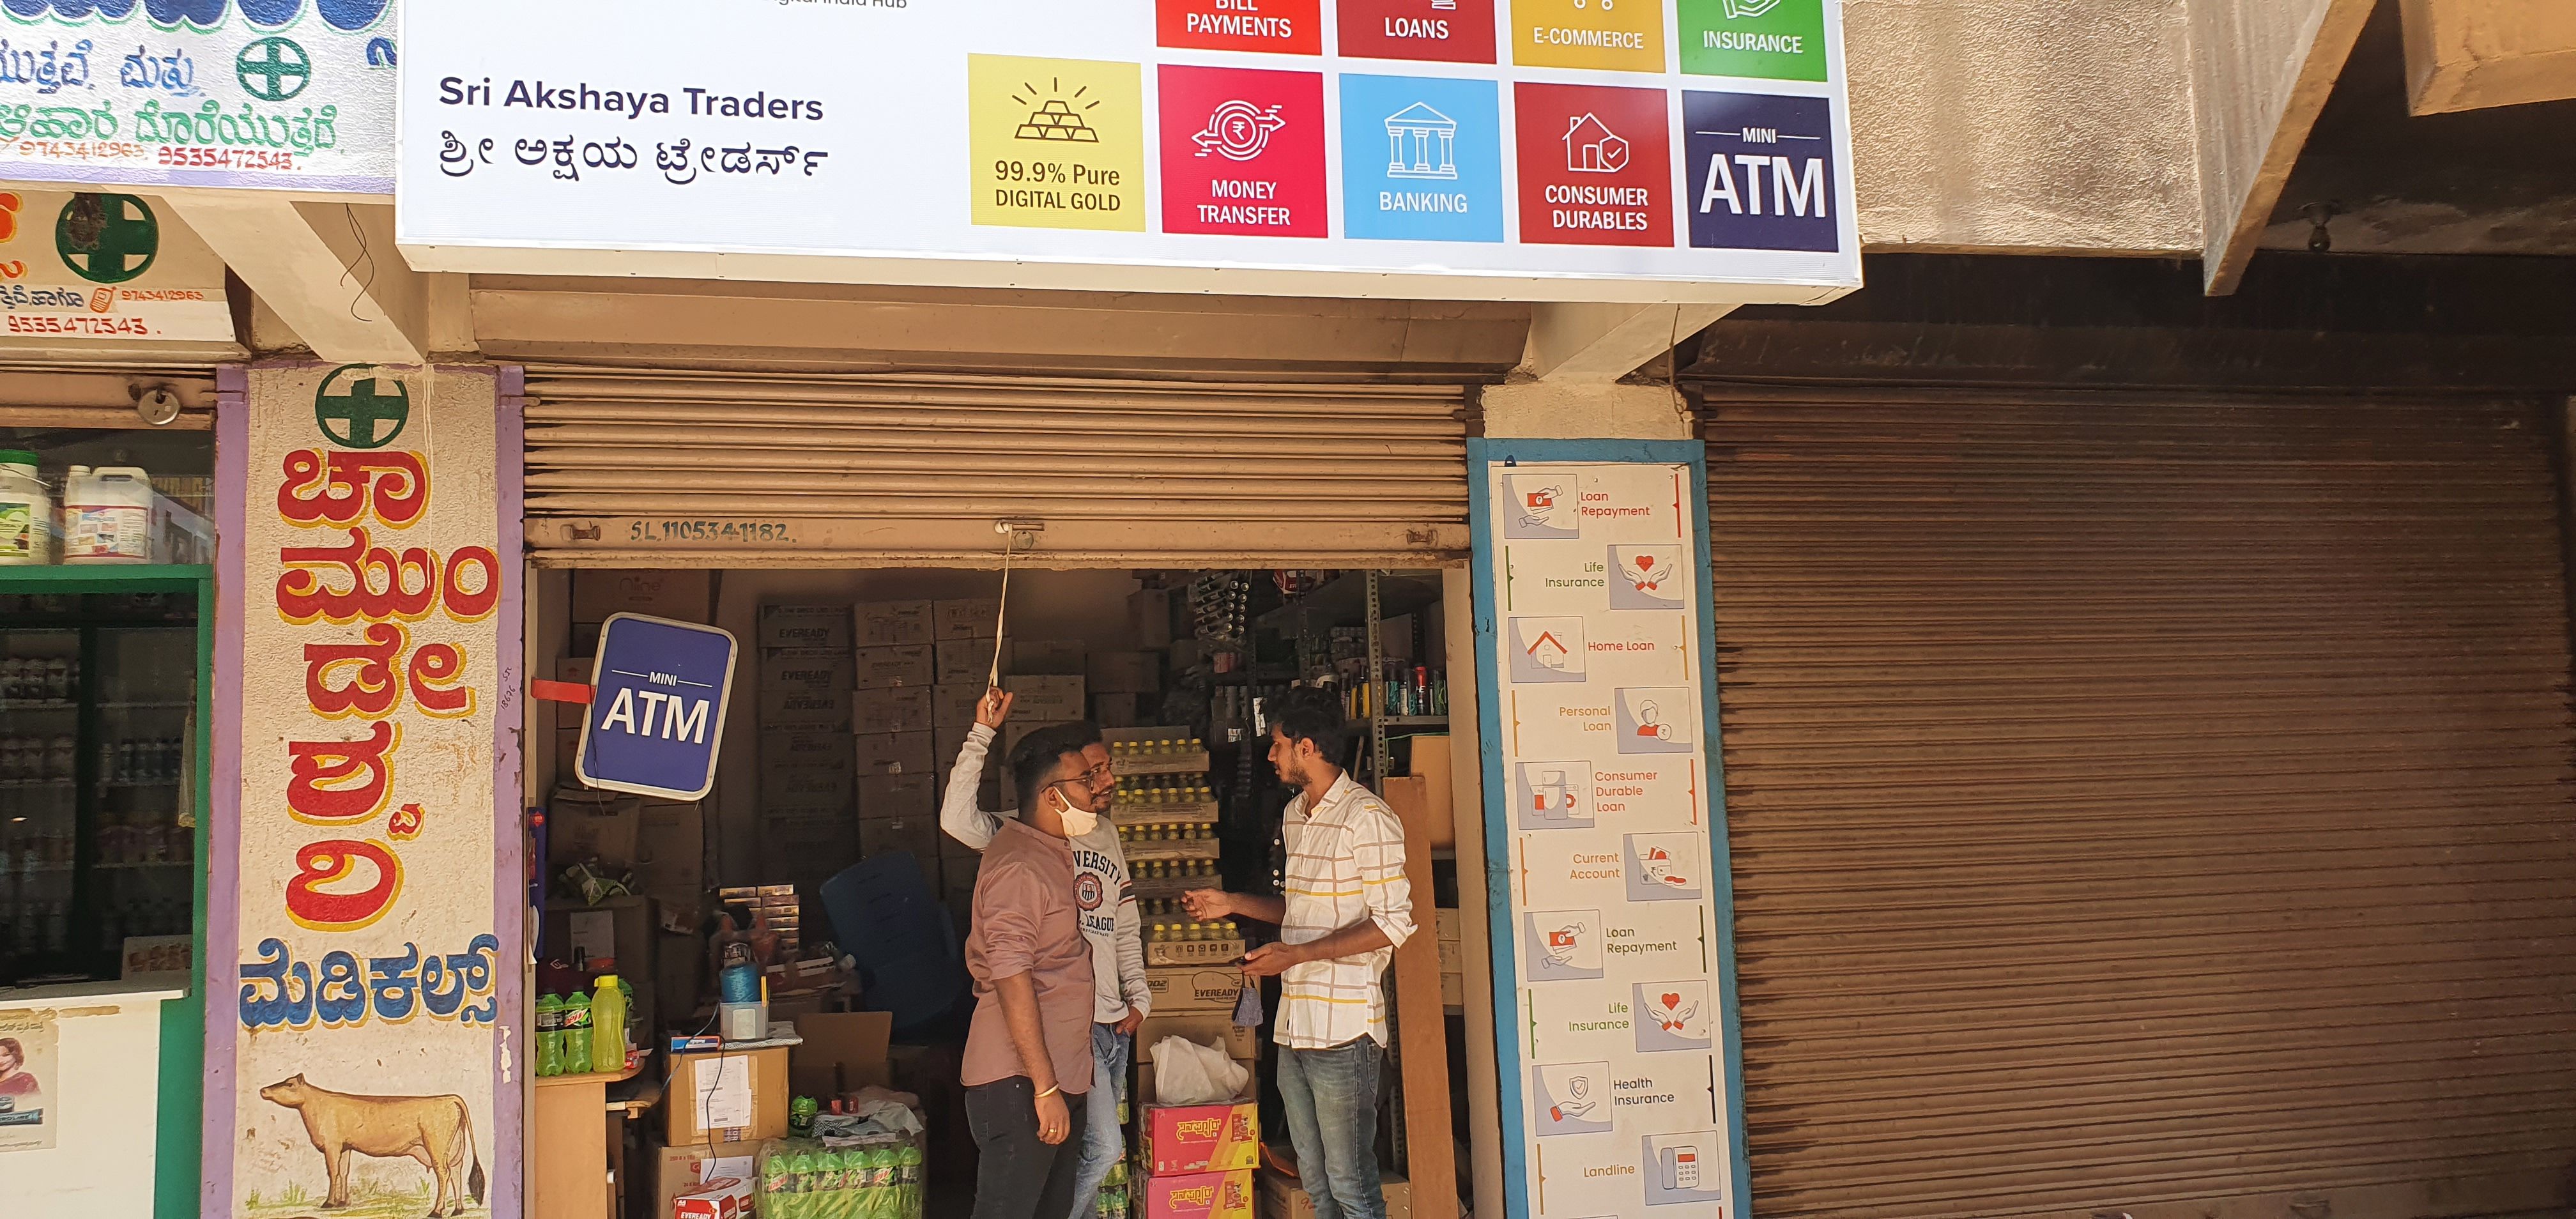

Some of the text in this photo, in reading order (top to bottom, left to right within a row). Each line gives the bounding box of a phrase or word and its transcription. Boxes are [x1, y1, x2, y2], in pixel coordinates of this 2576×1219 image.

[1186, 13, 1292, 38] PAYMENTS
[1384, 16, 1449, 40] LOANS
[1533, 27, 1644, 51] E-COMMERCE
[1703, 29, 1804, 55] INSURANCE
[438, 75, 824, 121] Sri Akshaya Traders
[1742, 126, 1778, 144] MINI
[439, 130, 494, 177] ಶ್ರೀ
[514, 134, 638, 183] ಅಕ್ಷಯ
[995, 160, 1121, 188] 99.9% Pure
[1211, 179, 1277, 203] MONEY
[1699, 153, 1826, 220] ATM
[994, 187, 1121, 213] DIGITAL GOLD
[1379, 191, 1468, 215] BANKING
[1545, 185, 1650, 209] CONSUMER
[1197, 203, 1291, 227] TRANSFER
[1552, 209, 1648, 232] DURABLES
[1581, 492, 1609, 502] Loan
[1581, 506, 1650, 519] Repayment
[1584, 562, 1604, 572] Life
[1545, 577, 1605, 588] Insurance
[779, 628, 830, 638] EVEREADY
[1588, 641, 1655, 652] Home Loan
[648, 671, 677, 687] MINI
[601, 687, 710, 745] ATM
[1559, 706, 1611, 717] Personal
[1583, 721, 1612, 732] Loan
[1595, 770, 1657, 781] Consumer
[1596, 785, 1643, 797] Durable
[1597, 801, 1625, 813] Loan
[1573, 852, 1619, 864] Current
[1569, 868, 1620, 880] Account
[1606, 926, 1635, 939] Loan
[1607, 940, 1677, 956] Repayment
[1194, 988, 1239, 997] EVEREADY
[1607, 1002, 1629, 1015] Life
[1568, 1020, 1630, 1032] Insurance
[1613, 1077, 1653, 1091] Health
[1614, 1091, 1675, 1107] Insurance
[1583, 1163, 1636, 1178] Landline
